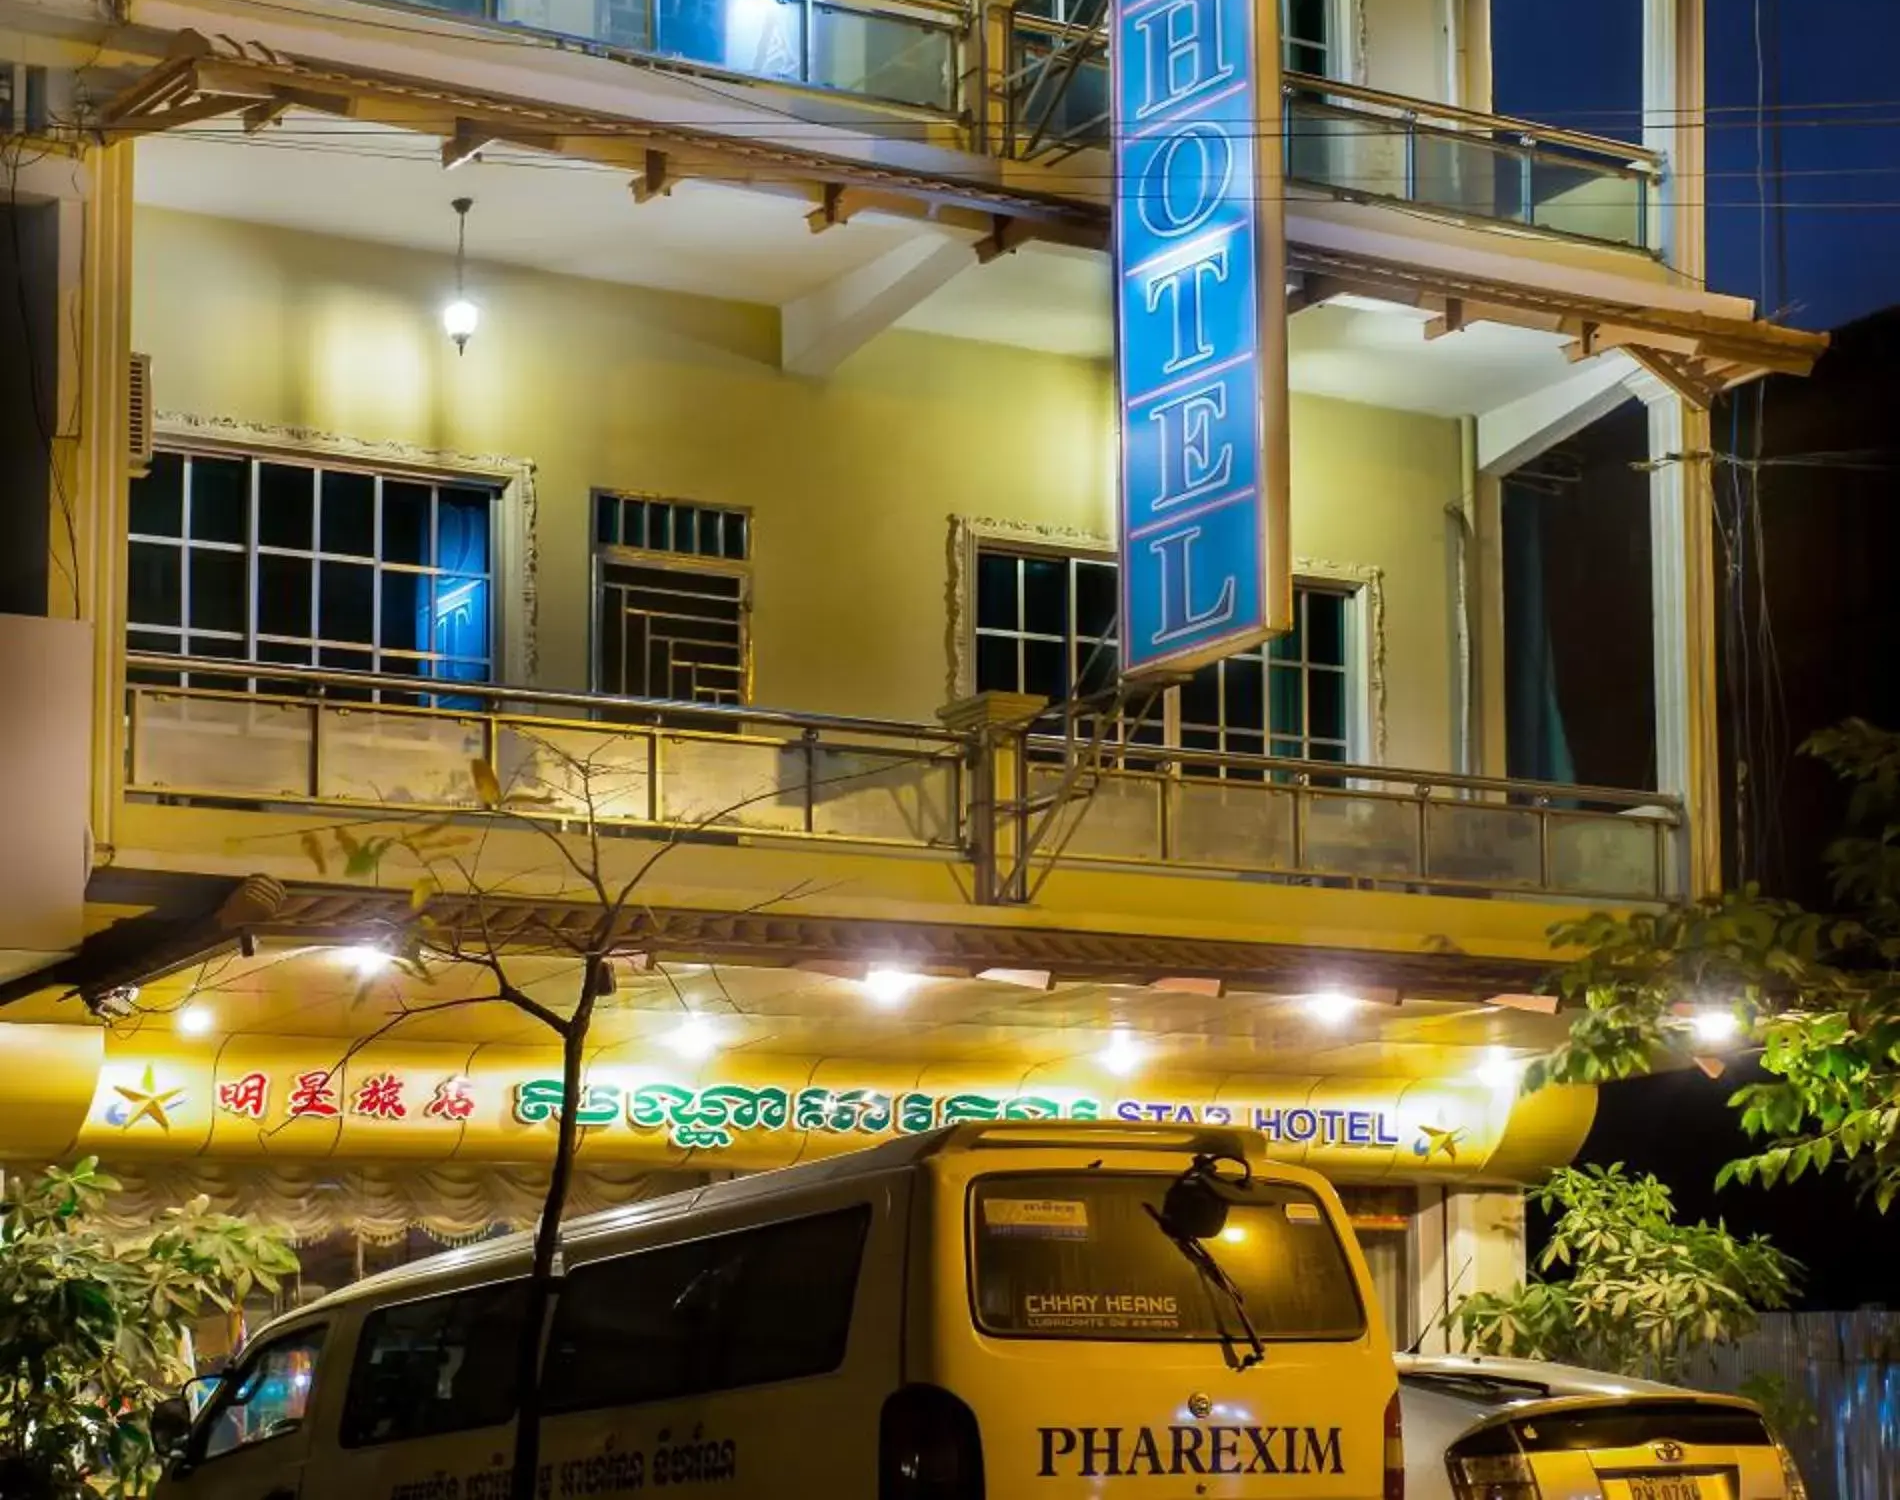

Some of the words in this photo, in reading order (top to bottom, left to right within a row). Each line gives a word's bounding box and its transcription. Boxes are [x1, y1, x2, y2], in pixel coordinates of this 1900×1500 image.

[218, 1072, 475, 1118] 明星旅店
[1255, 1108, 1399, 1142] HOTEL
[1025, 1294, 1098, 1314] CHHAY
[1106, 1295, 1178, 1315] HEANG
[1037, 1426, 1346, 1477] PHAREXIM
